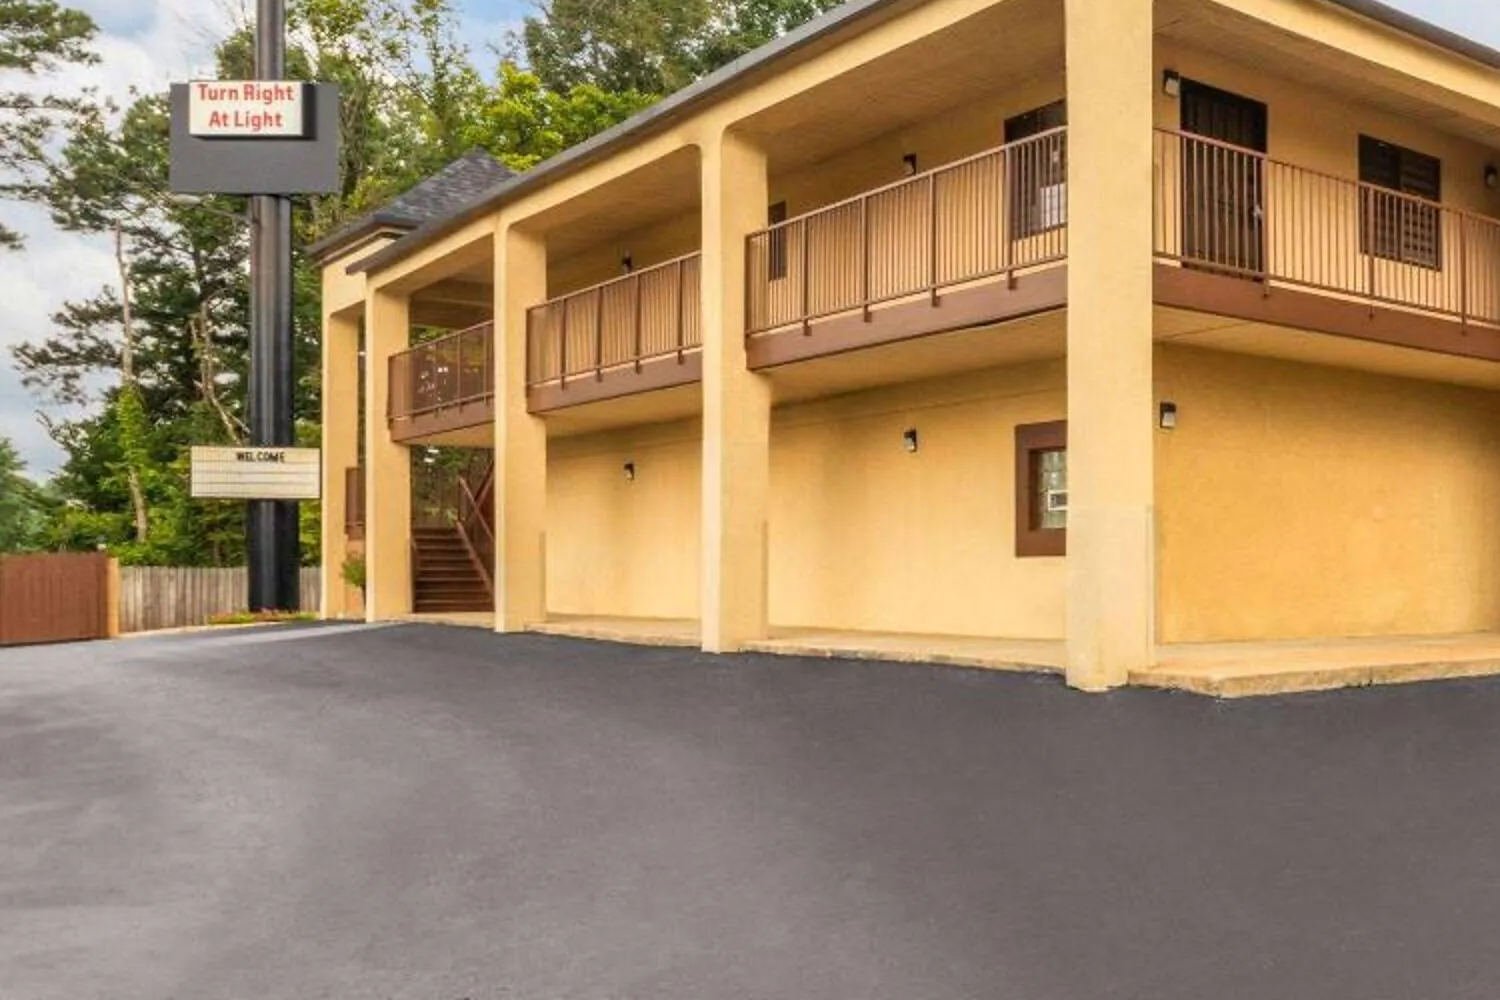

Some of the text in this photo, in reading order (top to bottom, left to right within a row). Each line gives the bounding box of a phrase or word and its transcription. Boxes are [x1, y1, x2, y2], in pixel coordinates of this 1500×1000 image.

[198, 83, 294, 105] Turn Right
[209, 110, 282, 132] At Light
[236, 451, 286, 463] WELCOME
